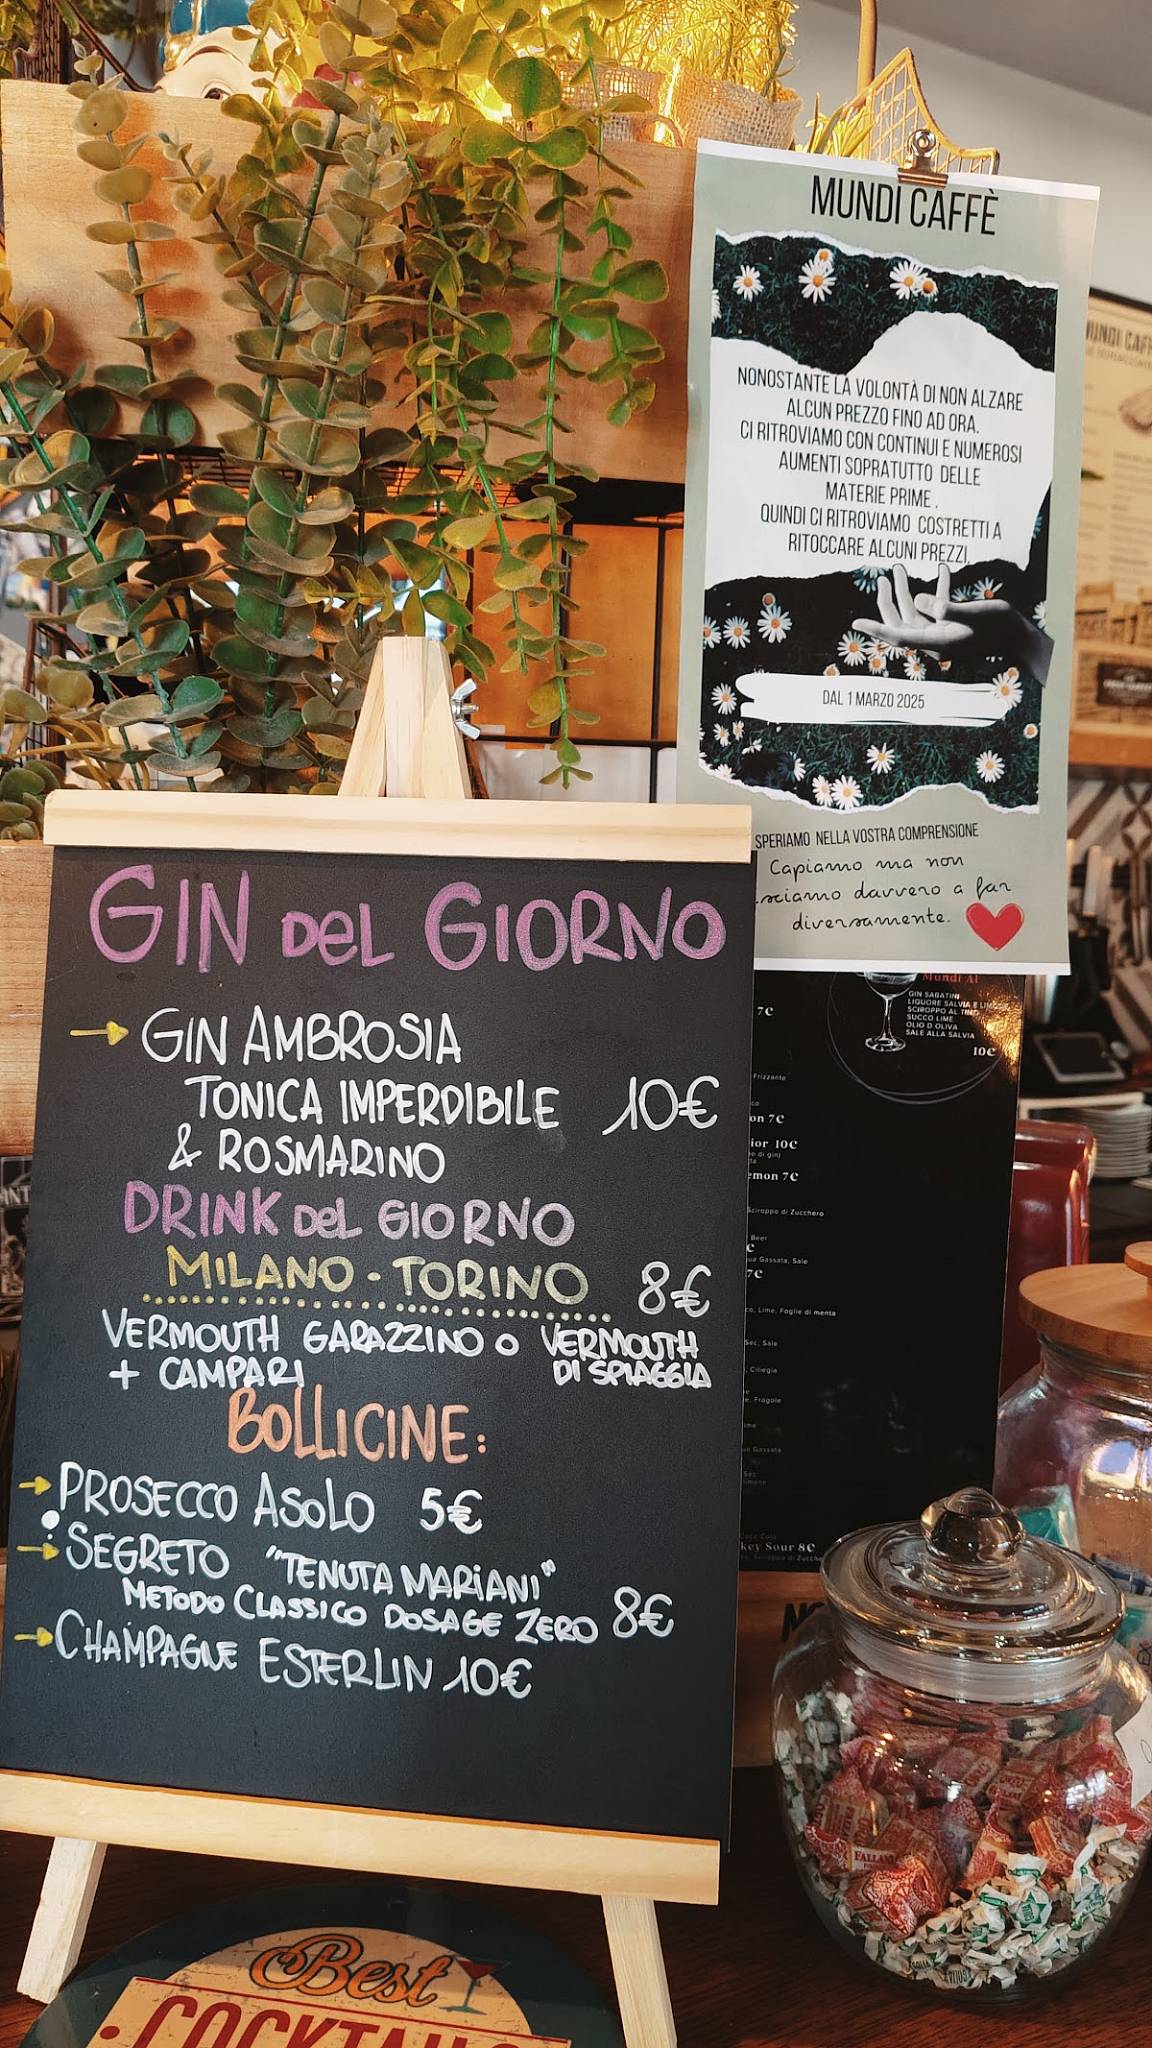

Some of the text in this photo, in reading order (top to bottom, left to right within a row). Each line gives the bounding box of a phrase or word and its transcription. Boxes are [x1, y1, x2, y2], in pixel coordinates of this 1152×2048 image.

[811, 175, 1000, 236] MUNDI CAFFÈ
[737, 366, 1024, 411] NONOSTANTE LA VOLONTÀ DI NON ALZARE
[786, 398, 980, 434] ALCUN PREZZO FINO AD ORA.
[740, 420, 1022, 464] CI RITROVIAMO CON CONTINUI E NUMEROSI
[779, 451, 981, 486] AUMENTI SOPRATUTTO DELLE
[826, 481, 931, 508] MATERIE PRIME
[760, 504, 1002, 540] QUINDI CI RITROVIAMO COSTRETTI A
[788, 533, 865, 556] RITOCCARE
[869, 539, 917, 560] ALCUNI
[823, 689, 925, 708] DAL 1 MARZO 2025
[755, 822, 979, 849] SPERIAMO NELLA VOSTRA COMPRENSIONE
[770, 855, 964, 882] Capiamo ma non
[755, 876, 1011, 904] sciamo davvero a far
[89, 864, 249, 972] GIN
[424, 881, 726, 971] GIORNO
[792, 907, 951, 931] diversamente.
[907, 999, 941, 1007] LIQUORE
[944, 1000, 971, 1008] SALVIA
[907, 1006, 946, 1015] SCIROPPO
[924, 992, 960, 1000] SABATINI
[142, 1005, 461, 1065] GIN AMBROSIA
[906, 1021, 925, 1029] OLIO
[907, 1013, 933, 1021] SUCCO
[184, 1075, 719, 1135] TONICA IMPERDIBILE 10€
[168, 1123, 445, 1181] & ROSMARINO
[124, 1180, 282, 1239] DRINK
[378, 1197, 575, 1246] GIORNO
[790, 1208, 824, 1217] Zucchero
[167, 1245, 354, 1292] MILANO
[392, 1256, 588, 1305] TORINO
[638, 1261, 711, 1317] 8€
[102, 1308, 279, 1352] VERMOUTH
[303, 1319, 484, 1357] GARAZZINO
[541, 1323, 699, 1361] VERMOUTH
[109, 1355, 712, 1390] + CAMPARI DI SPIAGGIA
[60, 1461, 238, 1522] PROSECCO
[419, 1487, 483, 1534] 5€
[66, 1521, 230, 1579] SEGRETO
[765, 1541, 795, 1552] Sour
[515, 1608, 598, 1644] ZERO
[613, 1586, 674, 1639] 8€
[55, 1608, 532, 1699] CHAMPAGNE ESTERLIN 10€
[250, 1933, 456, 2008] Best
